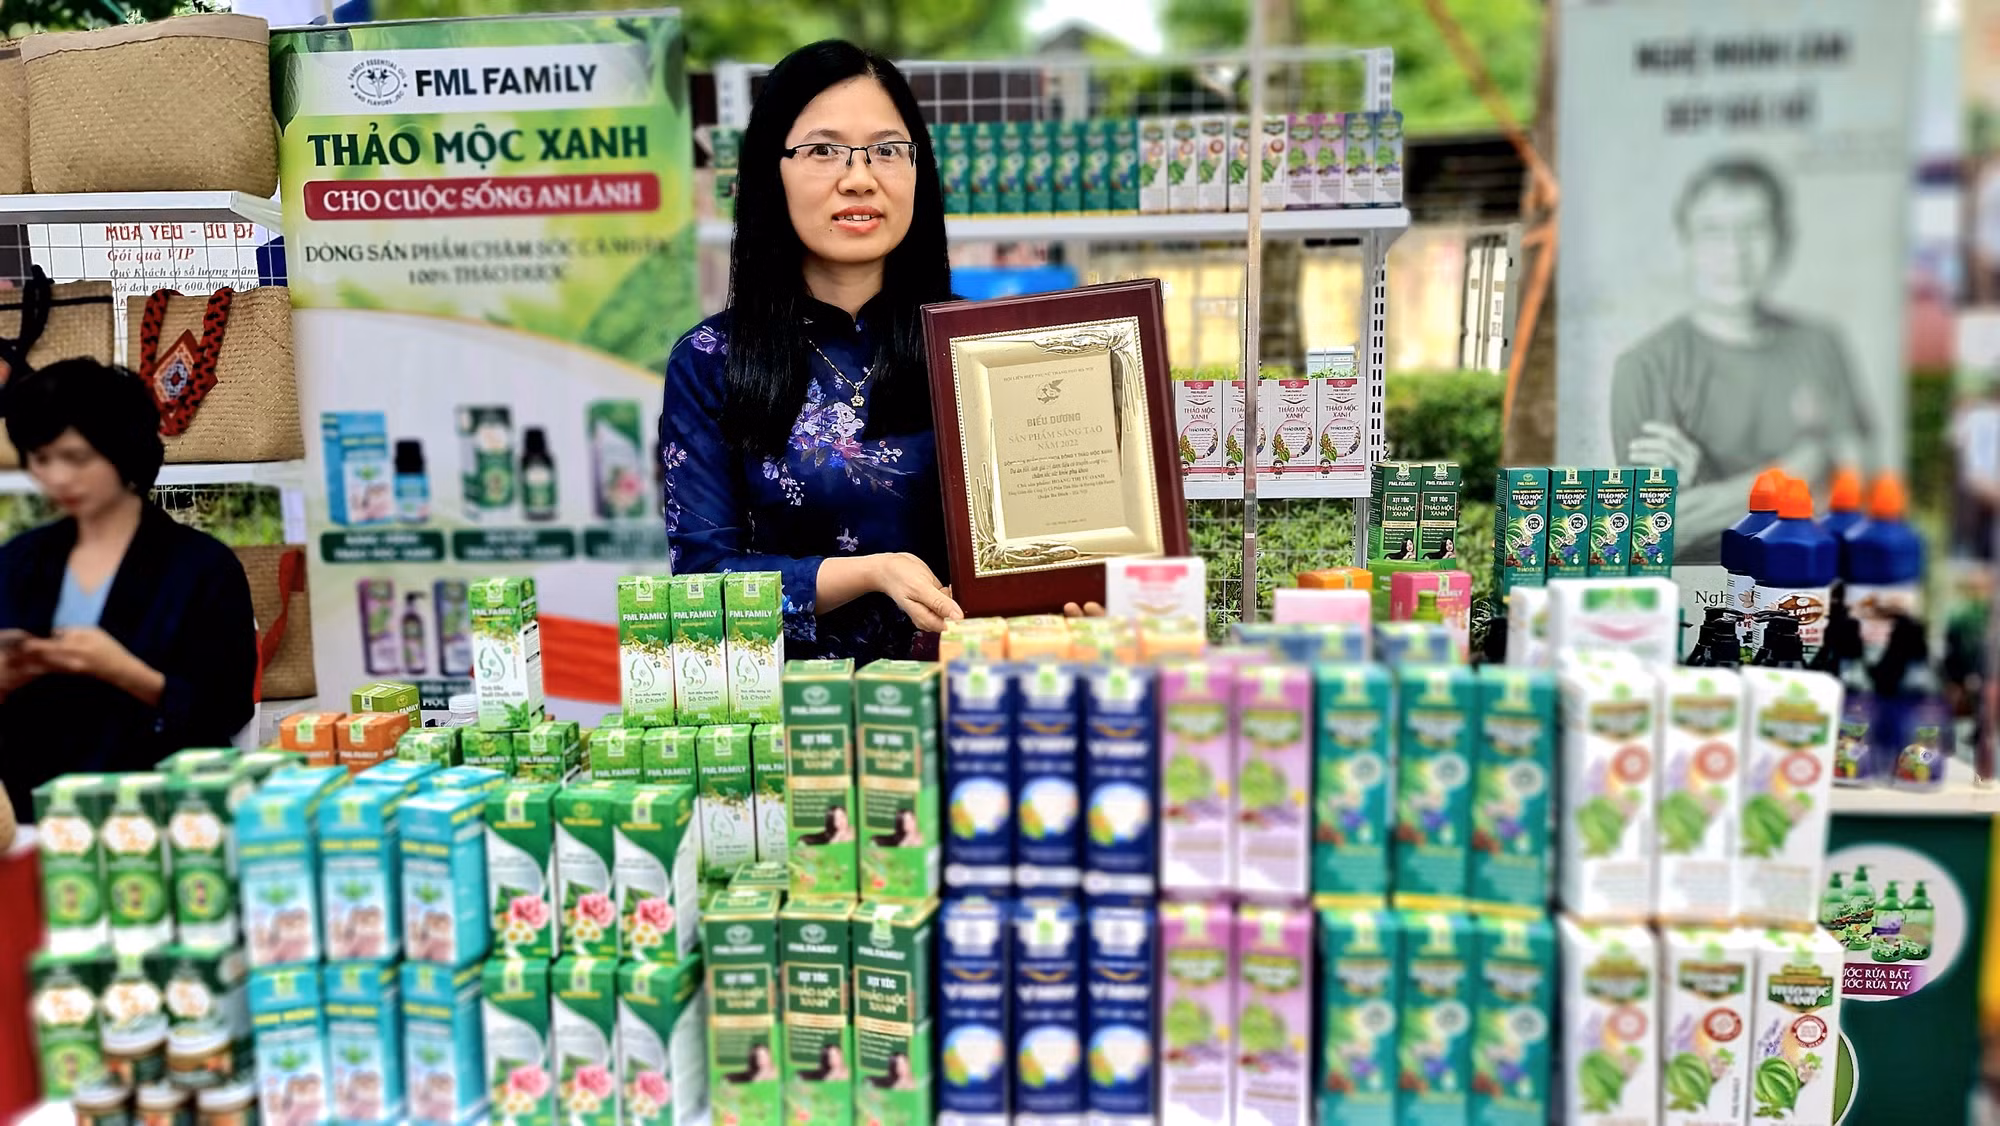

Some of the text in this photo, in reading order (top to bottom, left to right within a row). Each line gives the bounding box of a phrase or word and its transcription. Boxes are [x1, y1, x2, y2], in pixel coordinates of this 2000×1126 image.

[415, 68, 478, 97] FML
[307, 122, 648, 169] THẢO MỘC XANH
[323, 179, 642, 215] CHO CUỘC SỐNG AN LÀNH
[168, 248, 194, 260] VIP
[305, 242, 364, 263] DÒNG
[1060, 439, 1079, 449] 2022
[1386, 503, 1402, 511] THẢO
[1442, 504, 1454, 512] MỘC
[623, 613, 639, 621] FML
[674, 612, 688, 620] FML
[729, 610, 744, 618] FML
[1843, 967, 1862, 978] ƯỚC
[1865, 966, 1886, 979] RỬA
[1842, 977, 1910, 991] ƯỚC RỬA TAY
